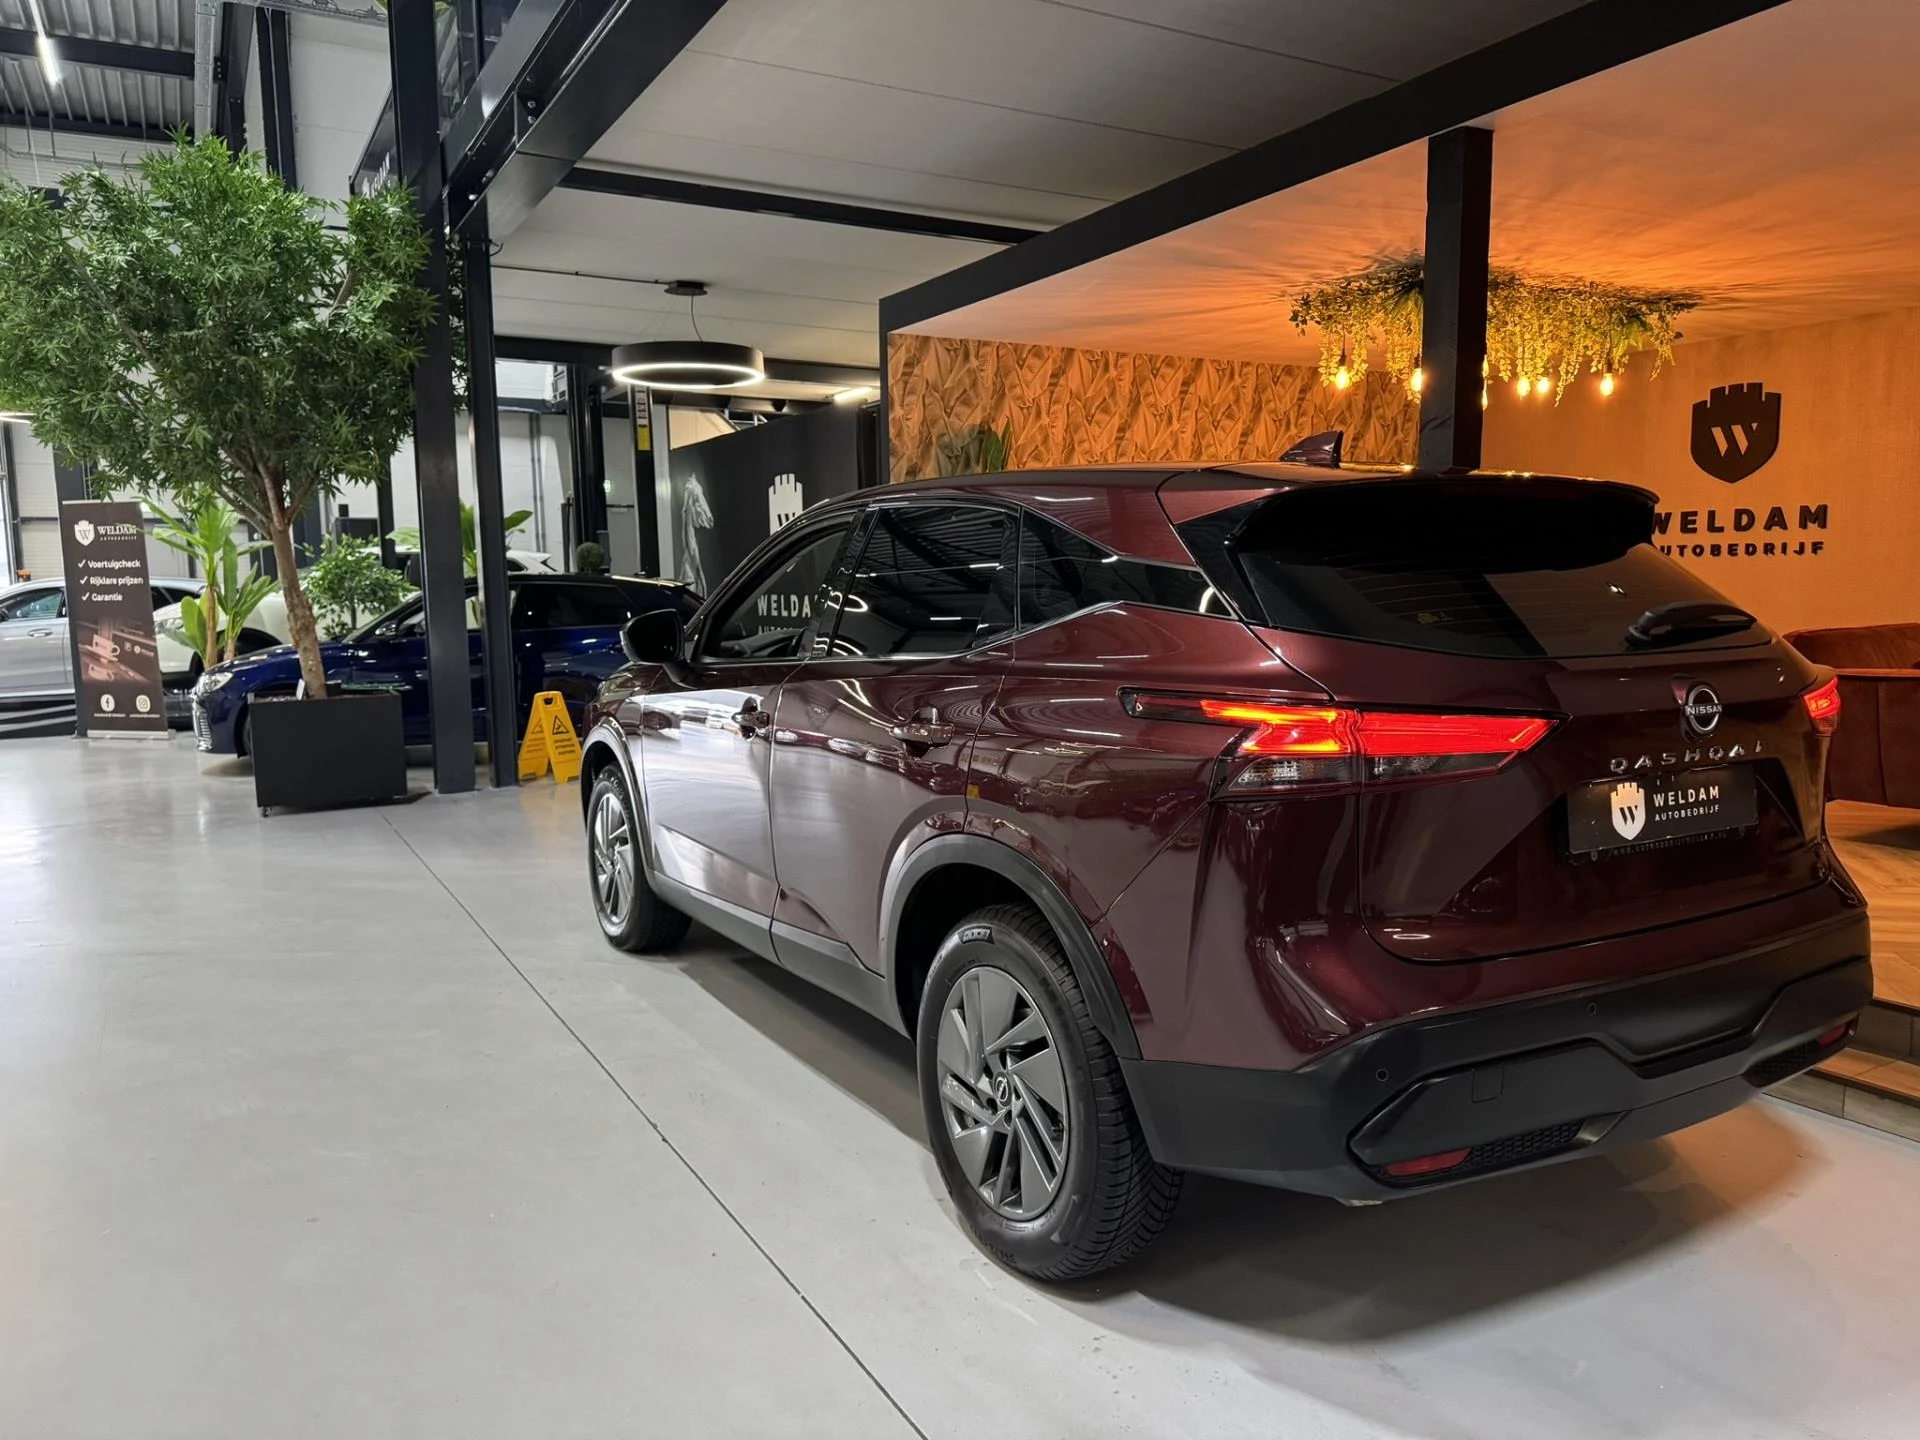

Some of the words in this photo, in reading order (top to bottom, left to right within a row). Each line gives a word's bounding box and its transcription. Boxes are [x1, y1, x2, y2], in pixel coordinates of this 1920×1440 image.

[1652, 504, 1828, 535] WELDAM
[1659, 541, 1824, 557] UTOBEDRIJF
[87, 559, 141, 569] Voertuigcheck
[91, 592, 123, 601] Garantie
[757, 594, 817, 618] WELDA
[1686, 704, 1722, 716] NISSAN
[1610, 740, 1762, 774] QASHQAI
[1653, 785, 1719, 807] WELDAM
[1654, 804, 1720, 822] AUTOBEDRIJF
